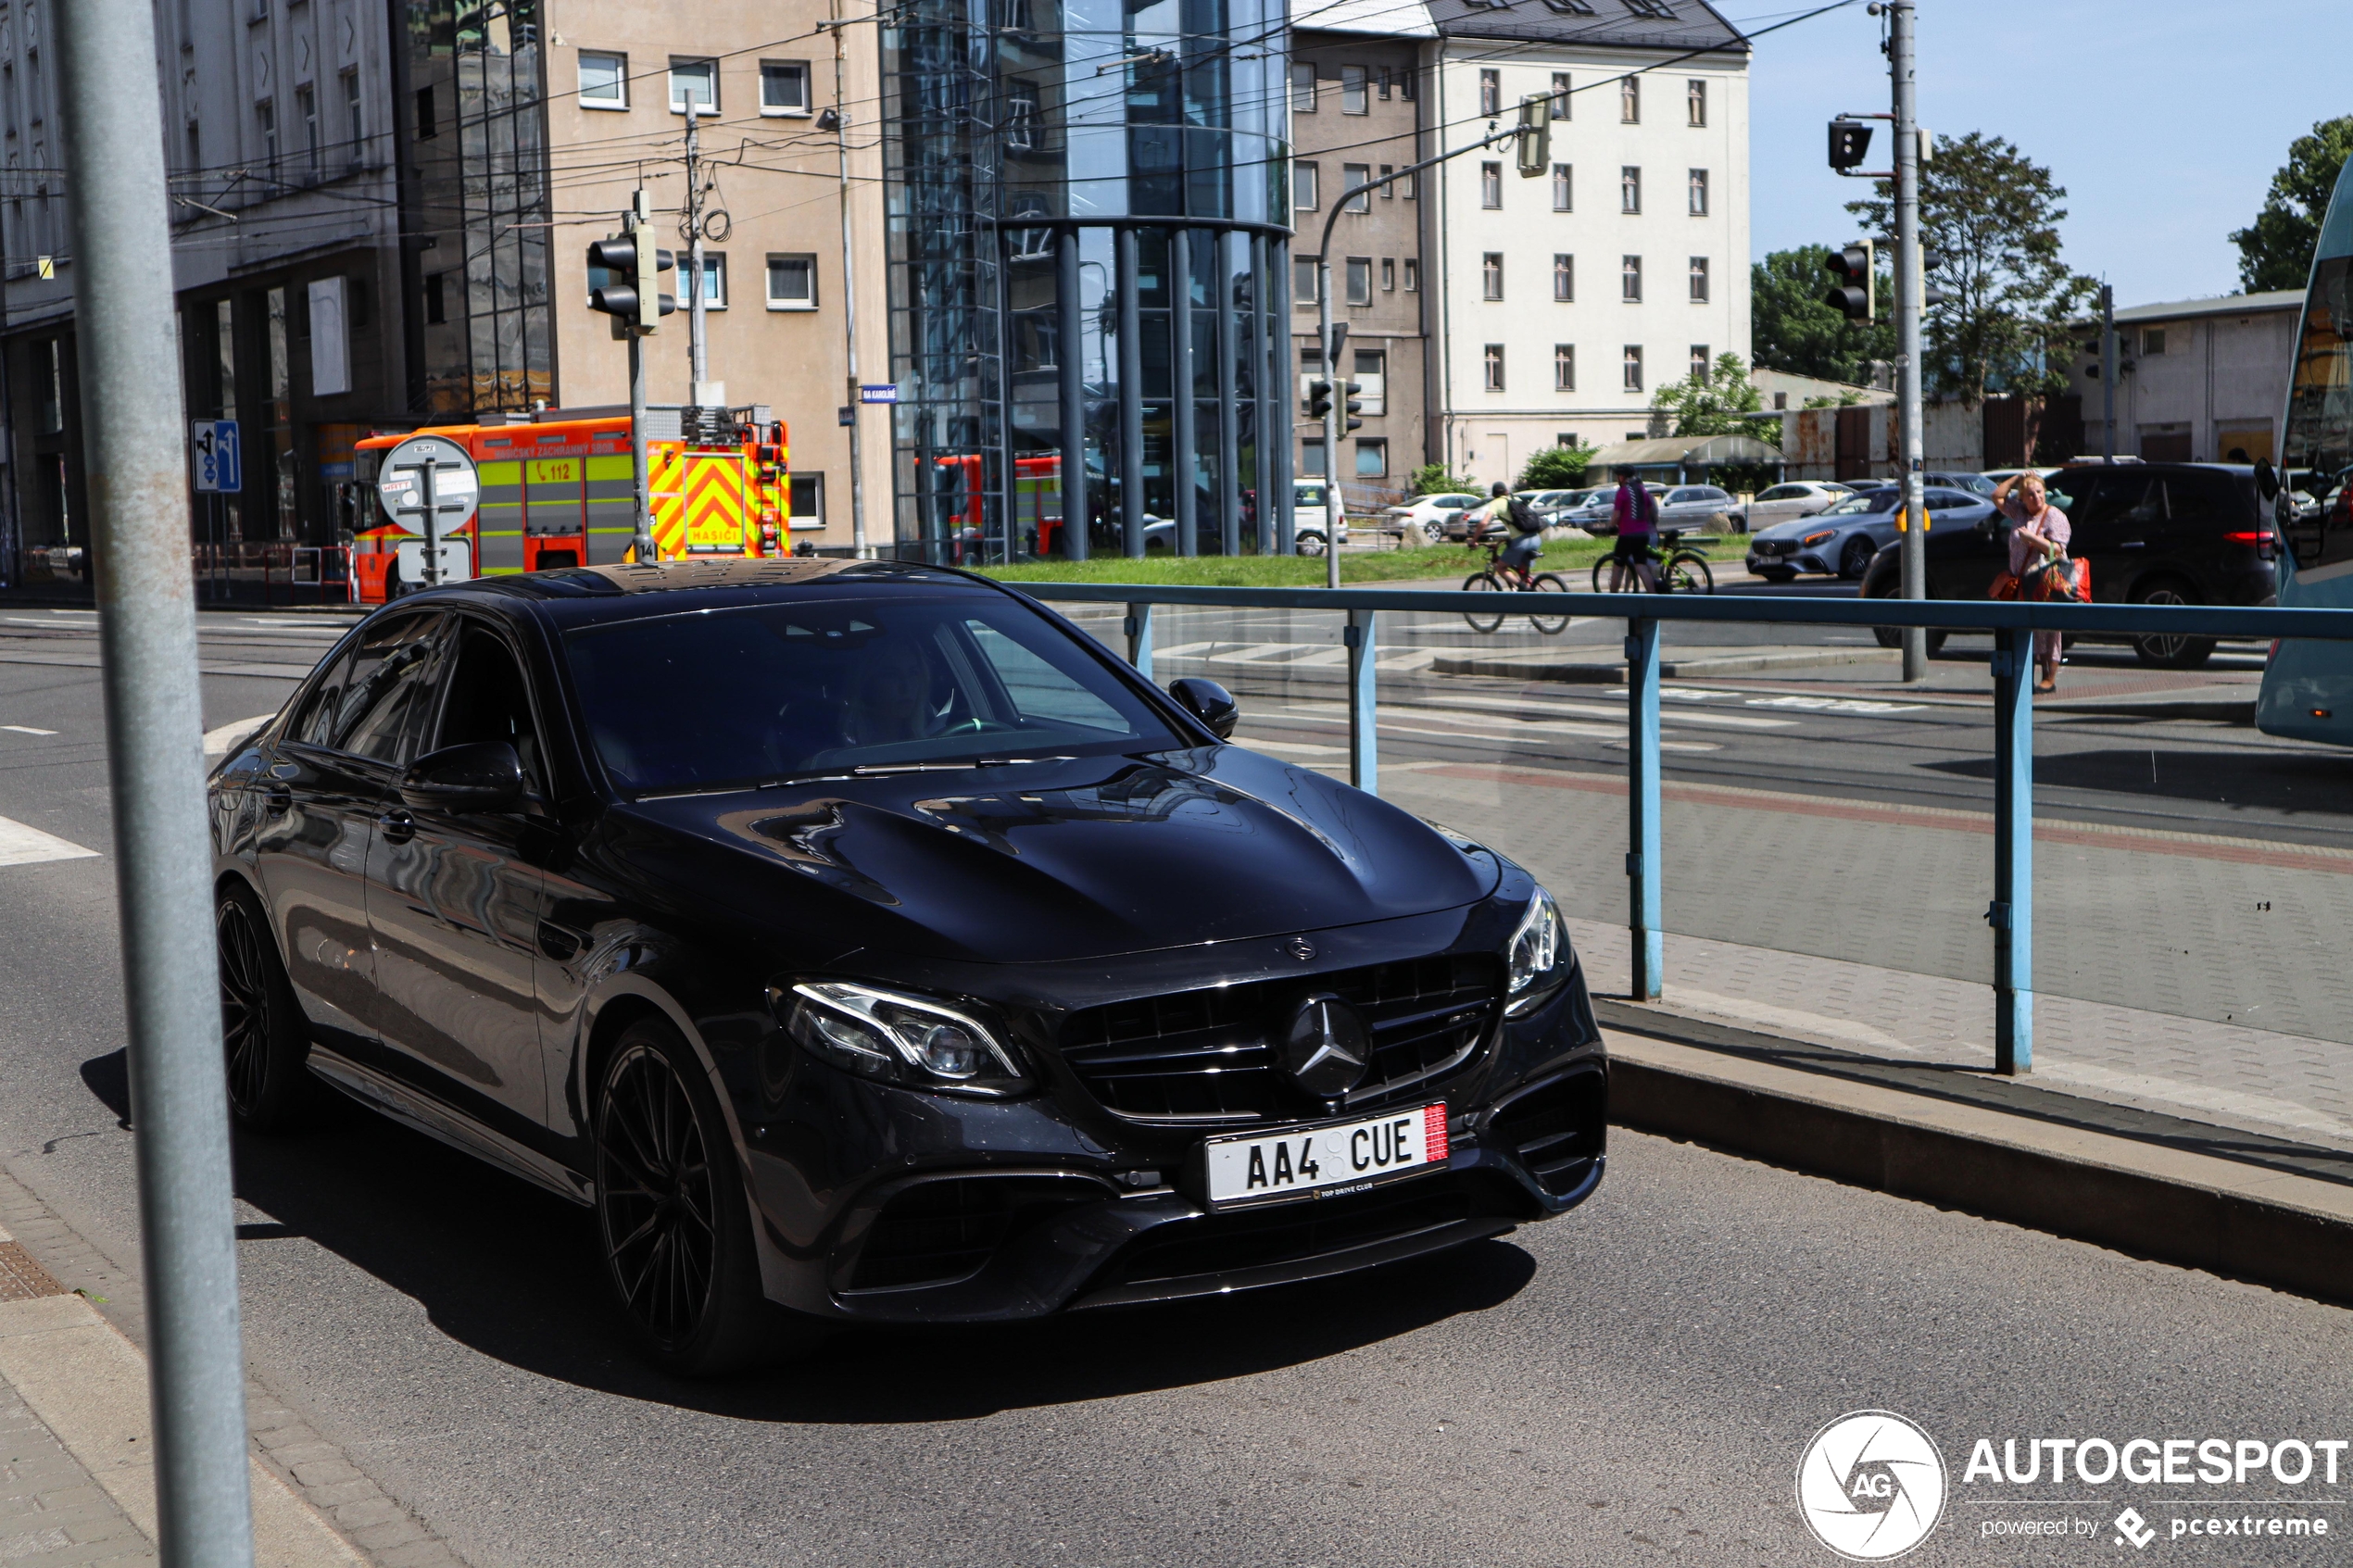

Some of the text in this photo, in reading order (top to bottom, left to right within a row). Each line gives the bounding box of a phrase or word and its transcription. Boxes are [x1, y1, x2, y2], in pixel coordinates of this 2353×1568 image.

[863, 390, 872, 399] NA
[495, 442, 615, 460] HASIČSKÝ ZÁCHRANNÝ SBOR
[550, 463, 570, 481] 112
[693, 529, 736, 541] HASIČI
[640, 544, 653, 558] 14
[1247, 1136, 1319, 1190] AA4
[1351, 1118, 1413, 1172] CUE
[1335, 1185, 1356, 1196] DRIVE
[1356, 1182, 1373, 1192] CLUB
